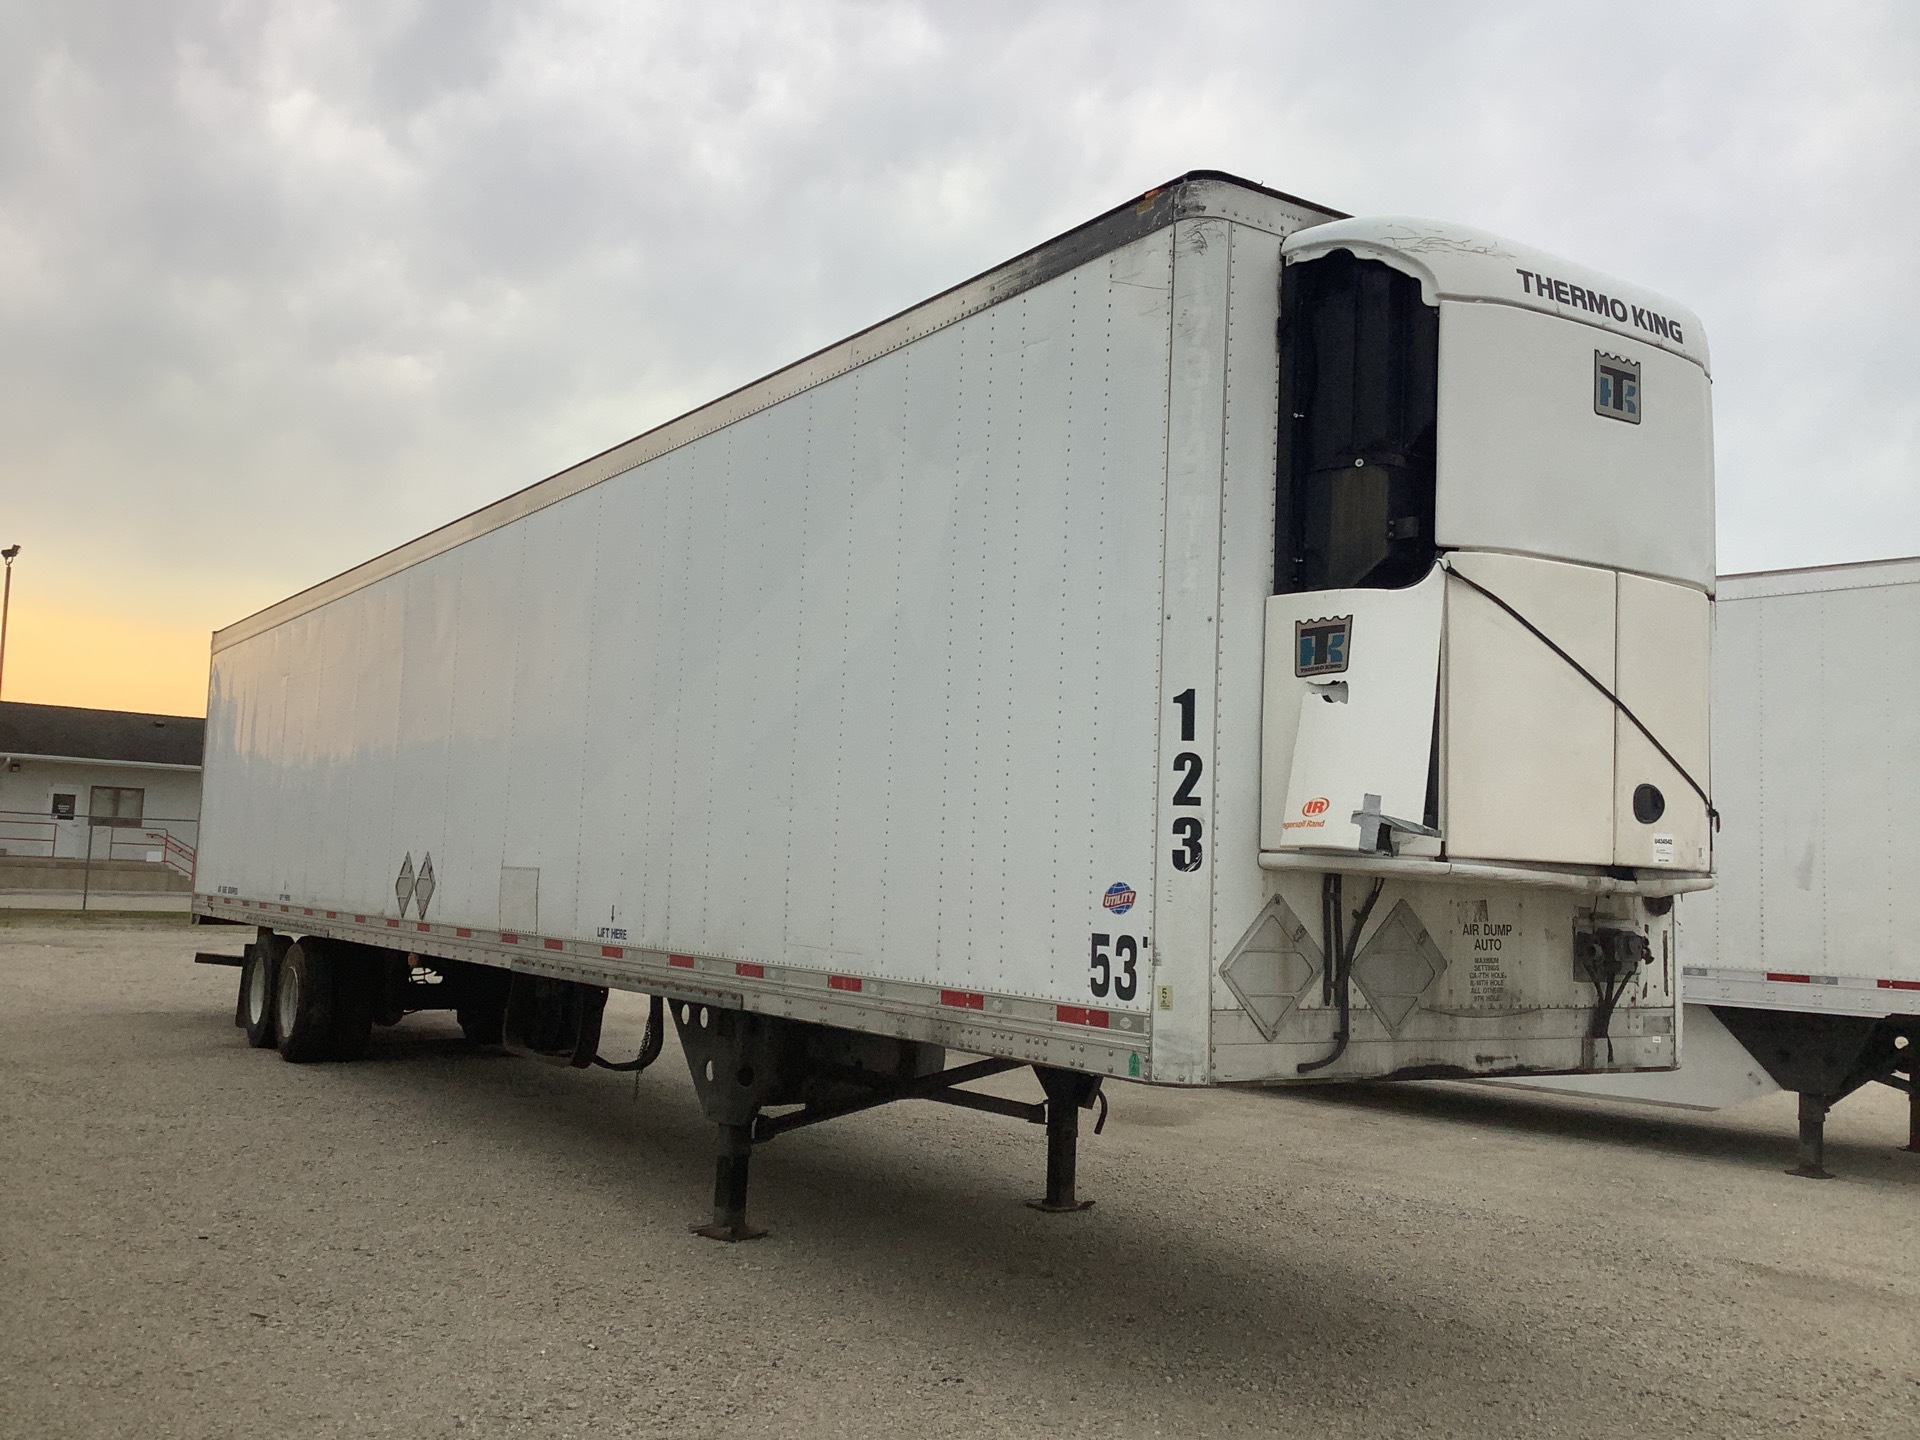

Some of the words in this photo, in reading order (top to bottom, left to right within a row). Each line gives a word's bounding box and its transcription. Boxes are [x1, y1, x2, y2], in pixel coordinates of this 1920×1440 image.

[1516, 268, 1628, 323] THERMO
[1631, 304, 1684, 344] KING
[1306, 801, 1325, 814] IR
[1306, 819, 1326, 828] Rand
[1104, 891, 1135, 907] UTILITY
[597, 927, 609, 938] LIFT
[611, 928, 627, 940] HERE
[1462, 923, 1480, 936] AIR
[1483, 924, 1512, 936] DUMP
[1474, 938, 1502, 951] AUTO
[1490, 979, 1505, 987] HOLE
[1470, 987, 1481, 995] ALL
